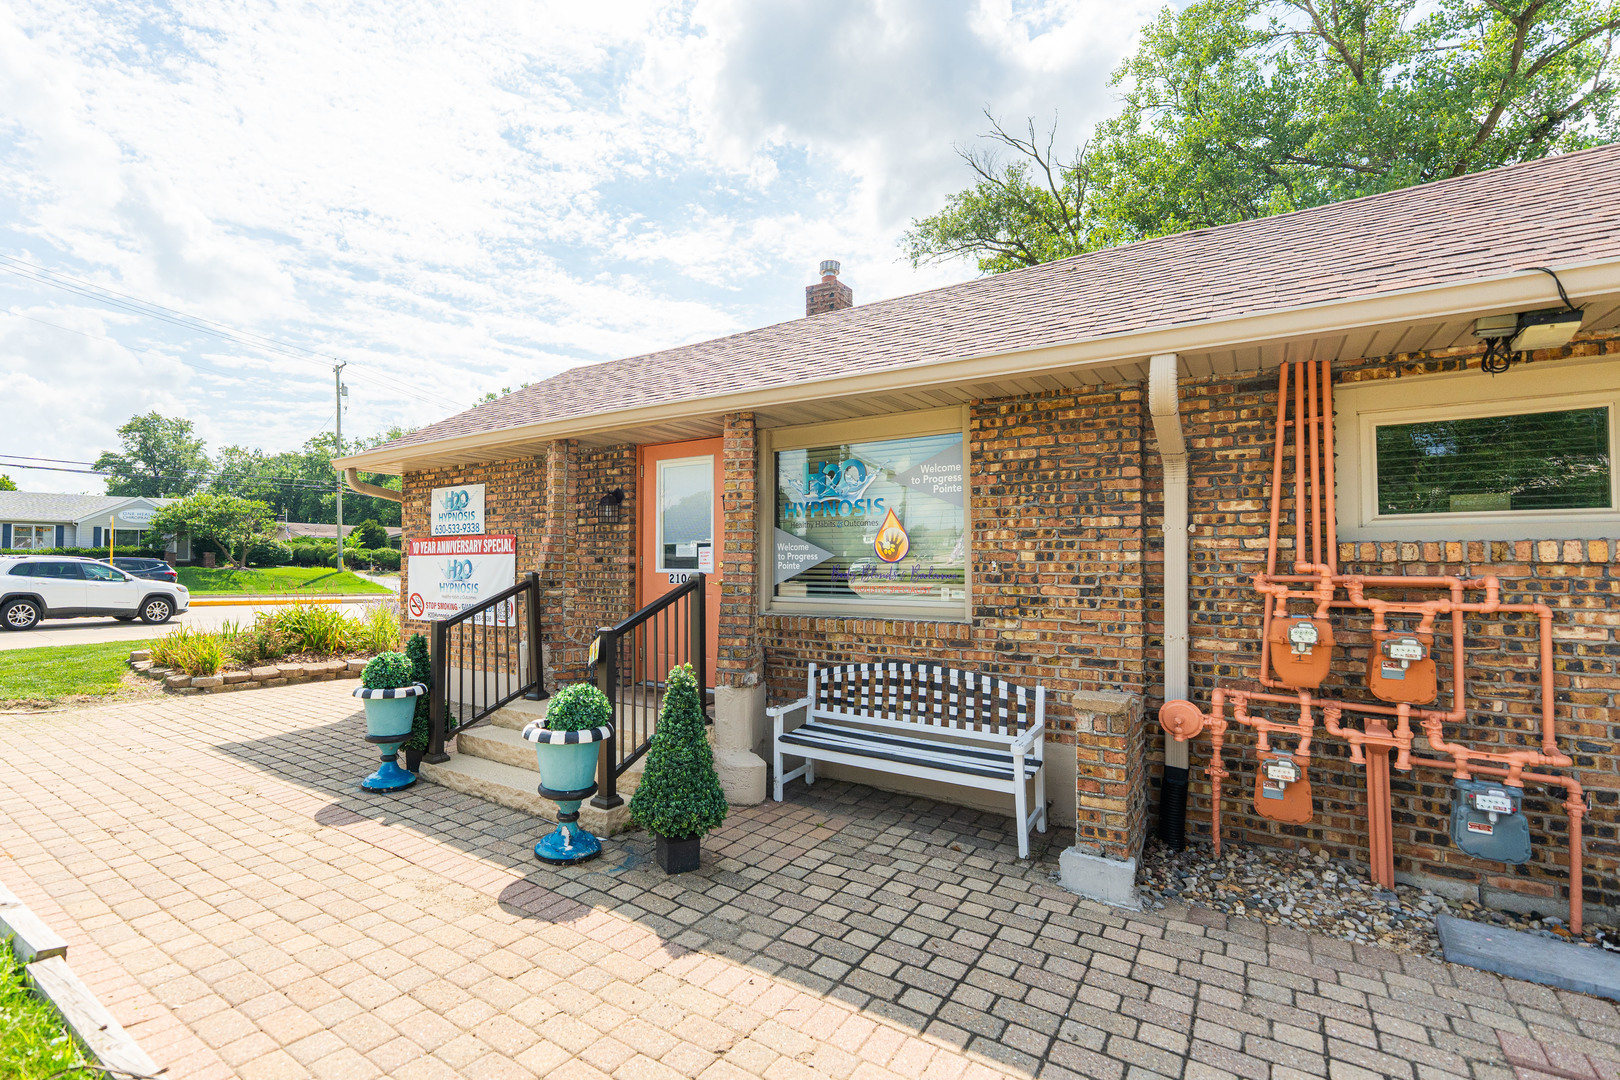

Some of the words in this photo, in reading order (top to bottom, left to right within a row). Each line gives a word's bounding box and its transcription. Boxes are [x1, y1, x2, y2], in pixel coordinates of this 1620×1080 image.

[920, 463, 961, 474] Welcome
[803, 459, 867, 497] H2O
[911, 476, 921, 485] to
[922, 474, 962, 485] Progress
[932, 484, 962, 493] Pointe
[445, 490, 469, 511] H2O
[784, 498, 885, 519] HYPNOSIS
[438, 511, 476, 522] HYPNOSIS
[435, 523, 480, 534] 630-533-9338
[790, 520, 814, 529] Healthy
[815, 520, 836, 528] Habits
[843, 519, 879, 527] Outcomes
[412, 542, 420, 554] 10
[420, 541, 436, 554] YEAR
[436, 539, 483, 553] ANNIVERSARY
[483, 538, 513, 552] SPECIAL
[776, 542, 809, 551] Welcome
[787, 552, 818, 563] Progress
[446, 559, 473, 581] H2O
[777, 561, 800, 570] Pointe
[439, 582, 479, 593] HYPNOSIS
[854, 585, 888, 594] HOLISTIC
[889, 586, 933, 595] SPECIALIST
[425, 601, 437, 610] STOP
[437, 602, 458, 611] SMOKING
